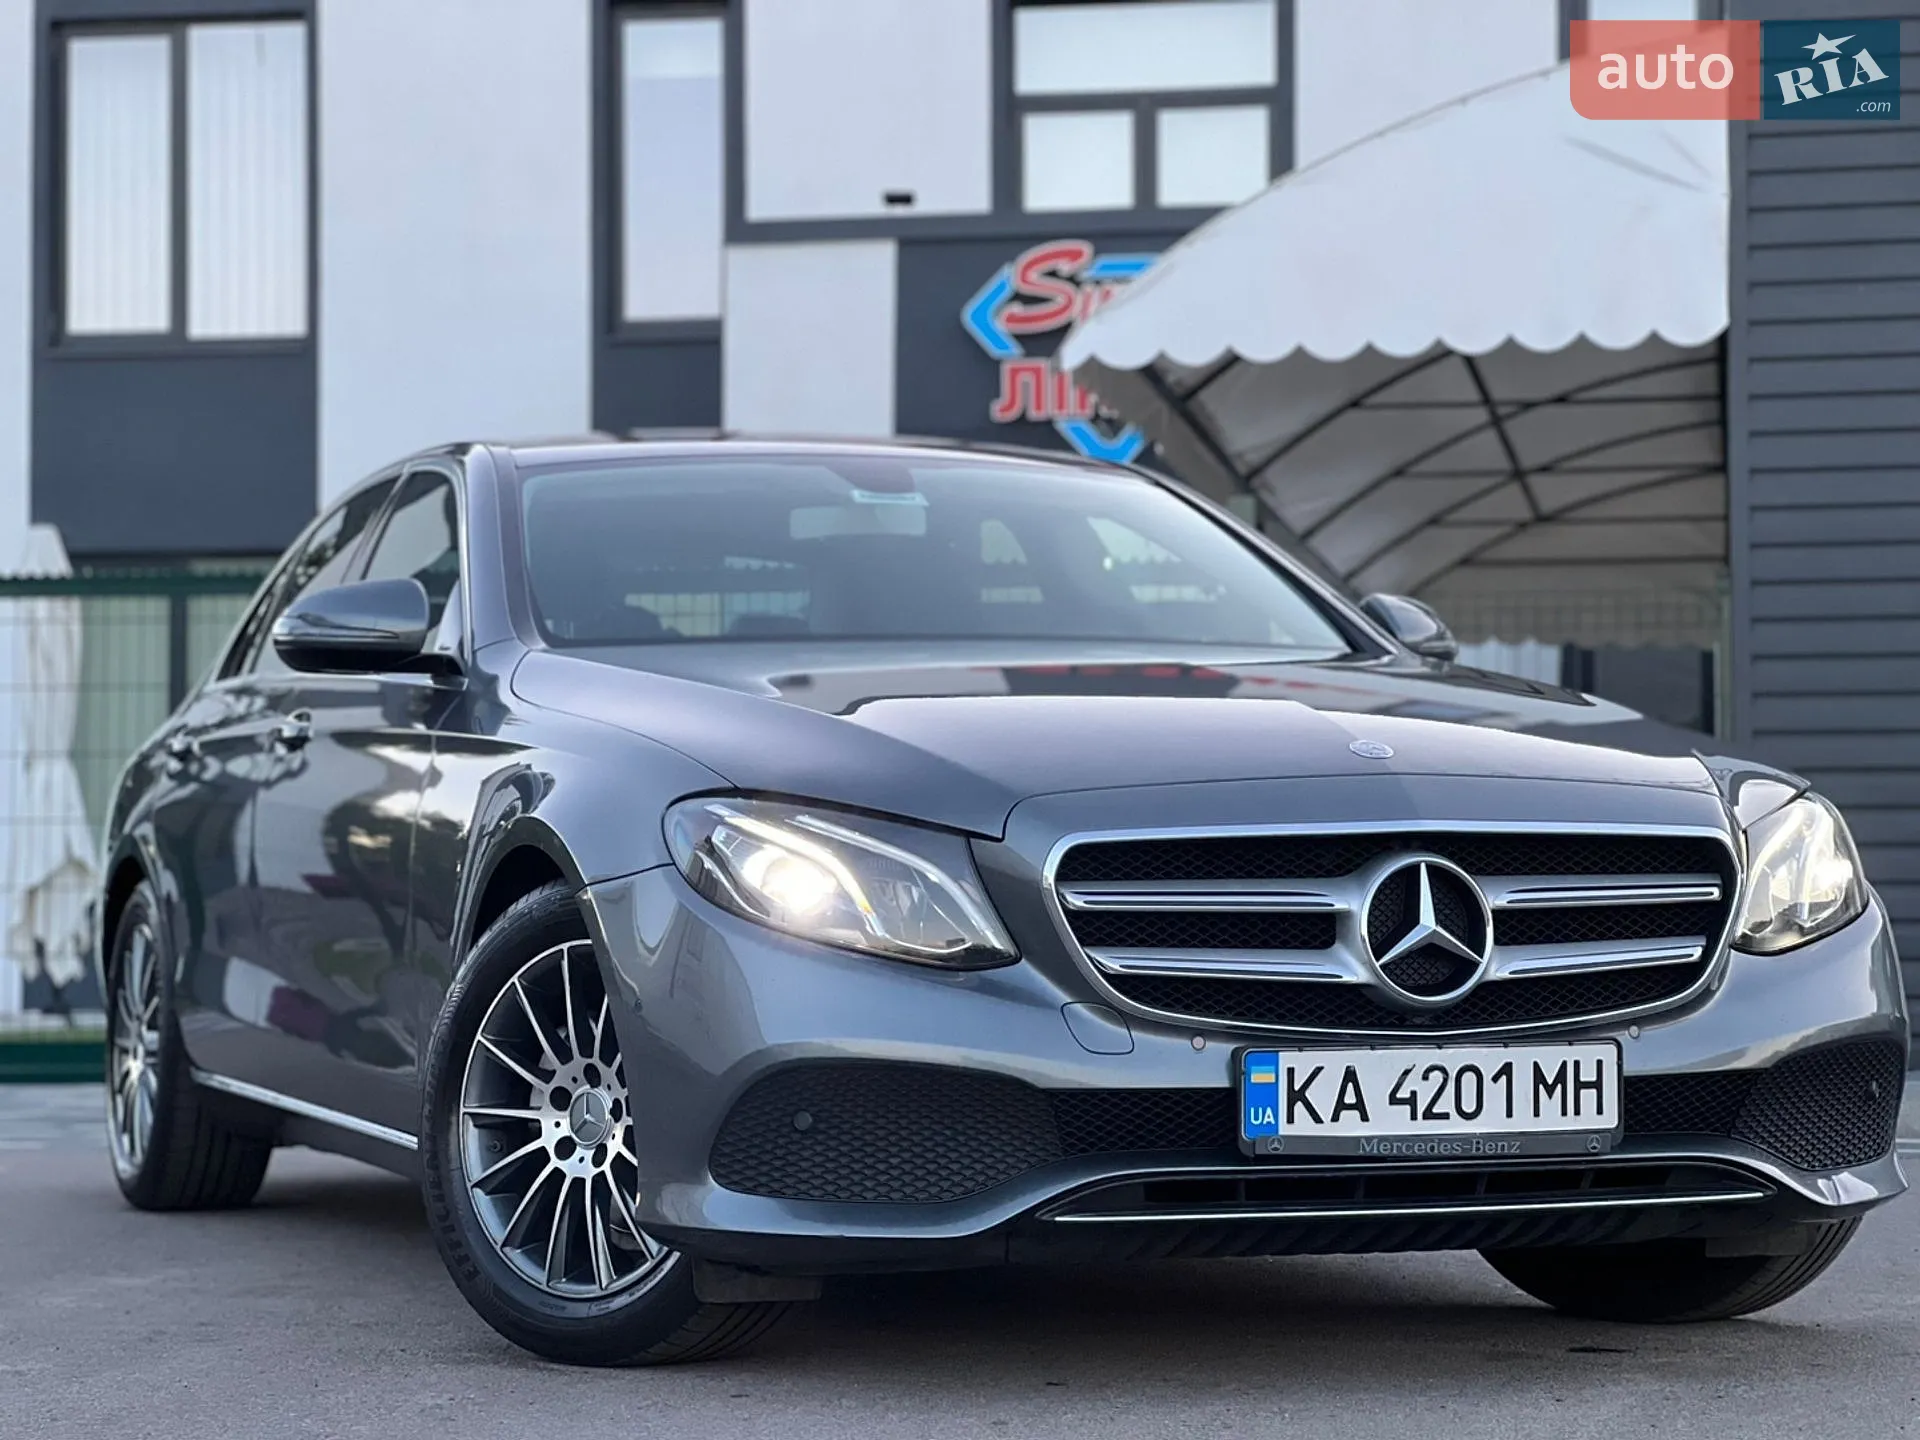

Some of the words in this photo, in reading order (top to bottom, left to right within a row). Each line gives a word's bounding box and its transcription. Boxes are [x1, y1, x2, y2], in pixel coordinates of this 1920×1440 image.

[1285, 1063, 1371, 1126] KA
[1388, 1061, 1514, 1122] 4201
[1532, 1058, 1604, 1119] MH
[1250, 1107, 1275, 1126] UA
[1358, 1136, 1522, 1155] Mercedes-Benz
